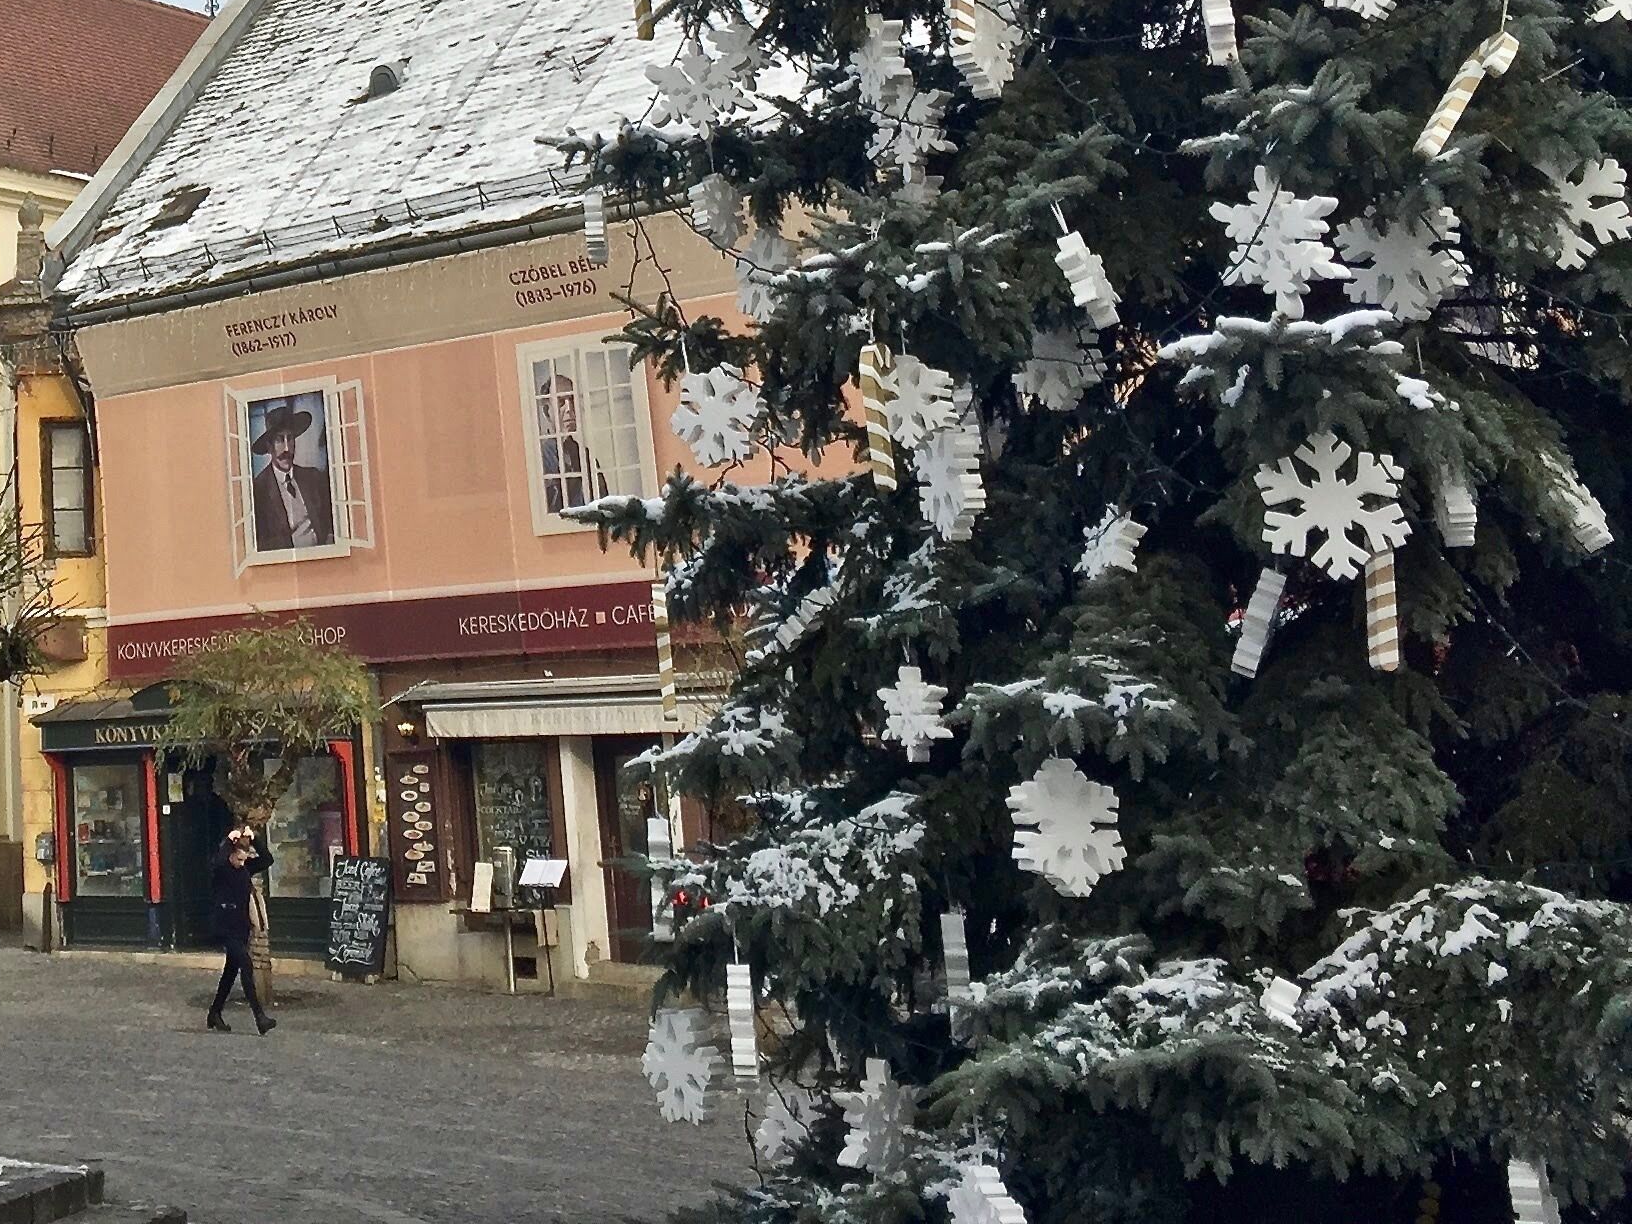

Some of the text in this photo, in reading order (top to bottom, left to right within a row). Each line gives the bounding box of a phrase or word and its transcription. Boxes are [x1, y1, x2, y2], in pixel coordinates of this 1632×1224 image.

[508, 264, 567, 286] CZÓBEL
[225, 304, 338, 338] FERENCZY KÁROLY
